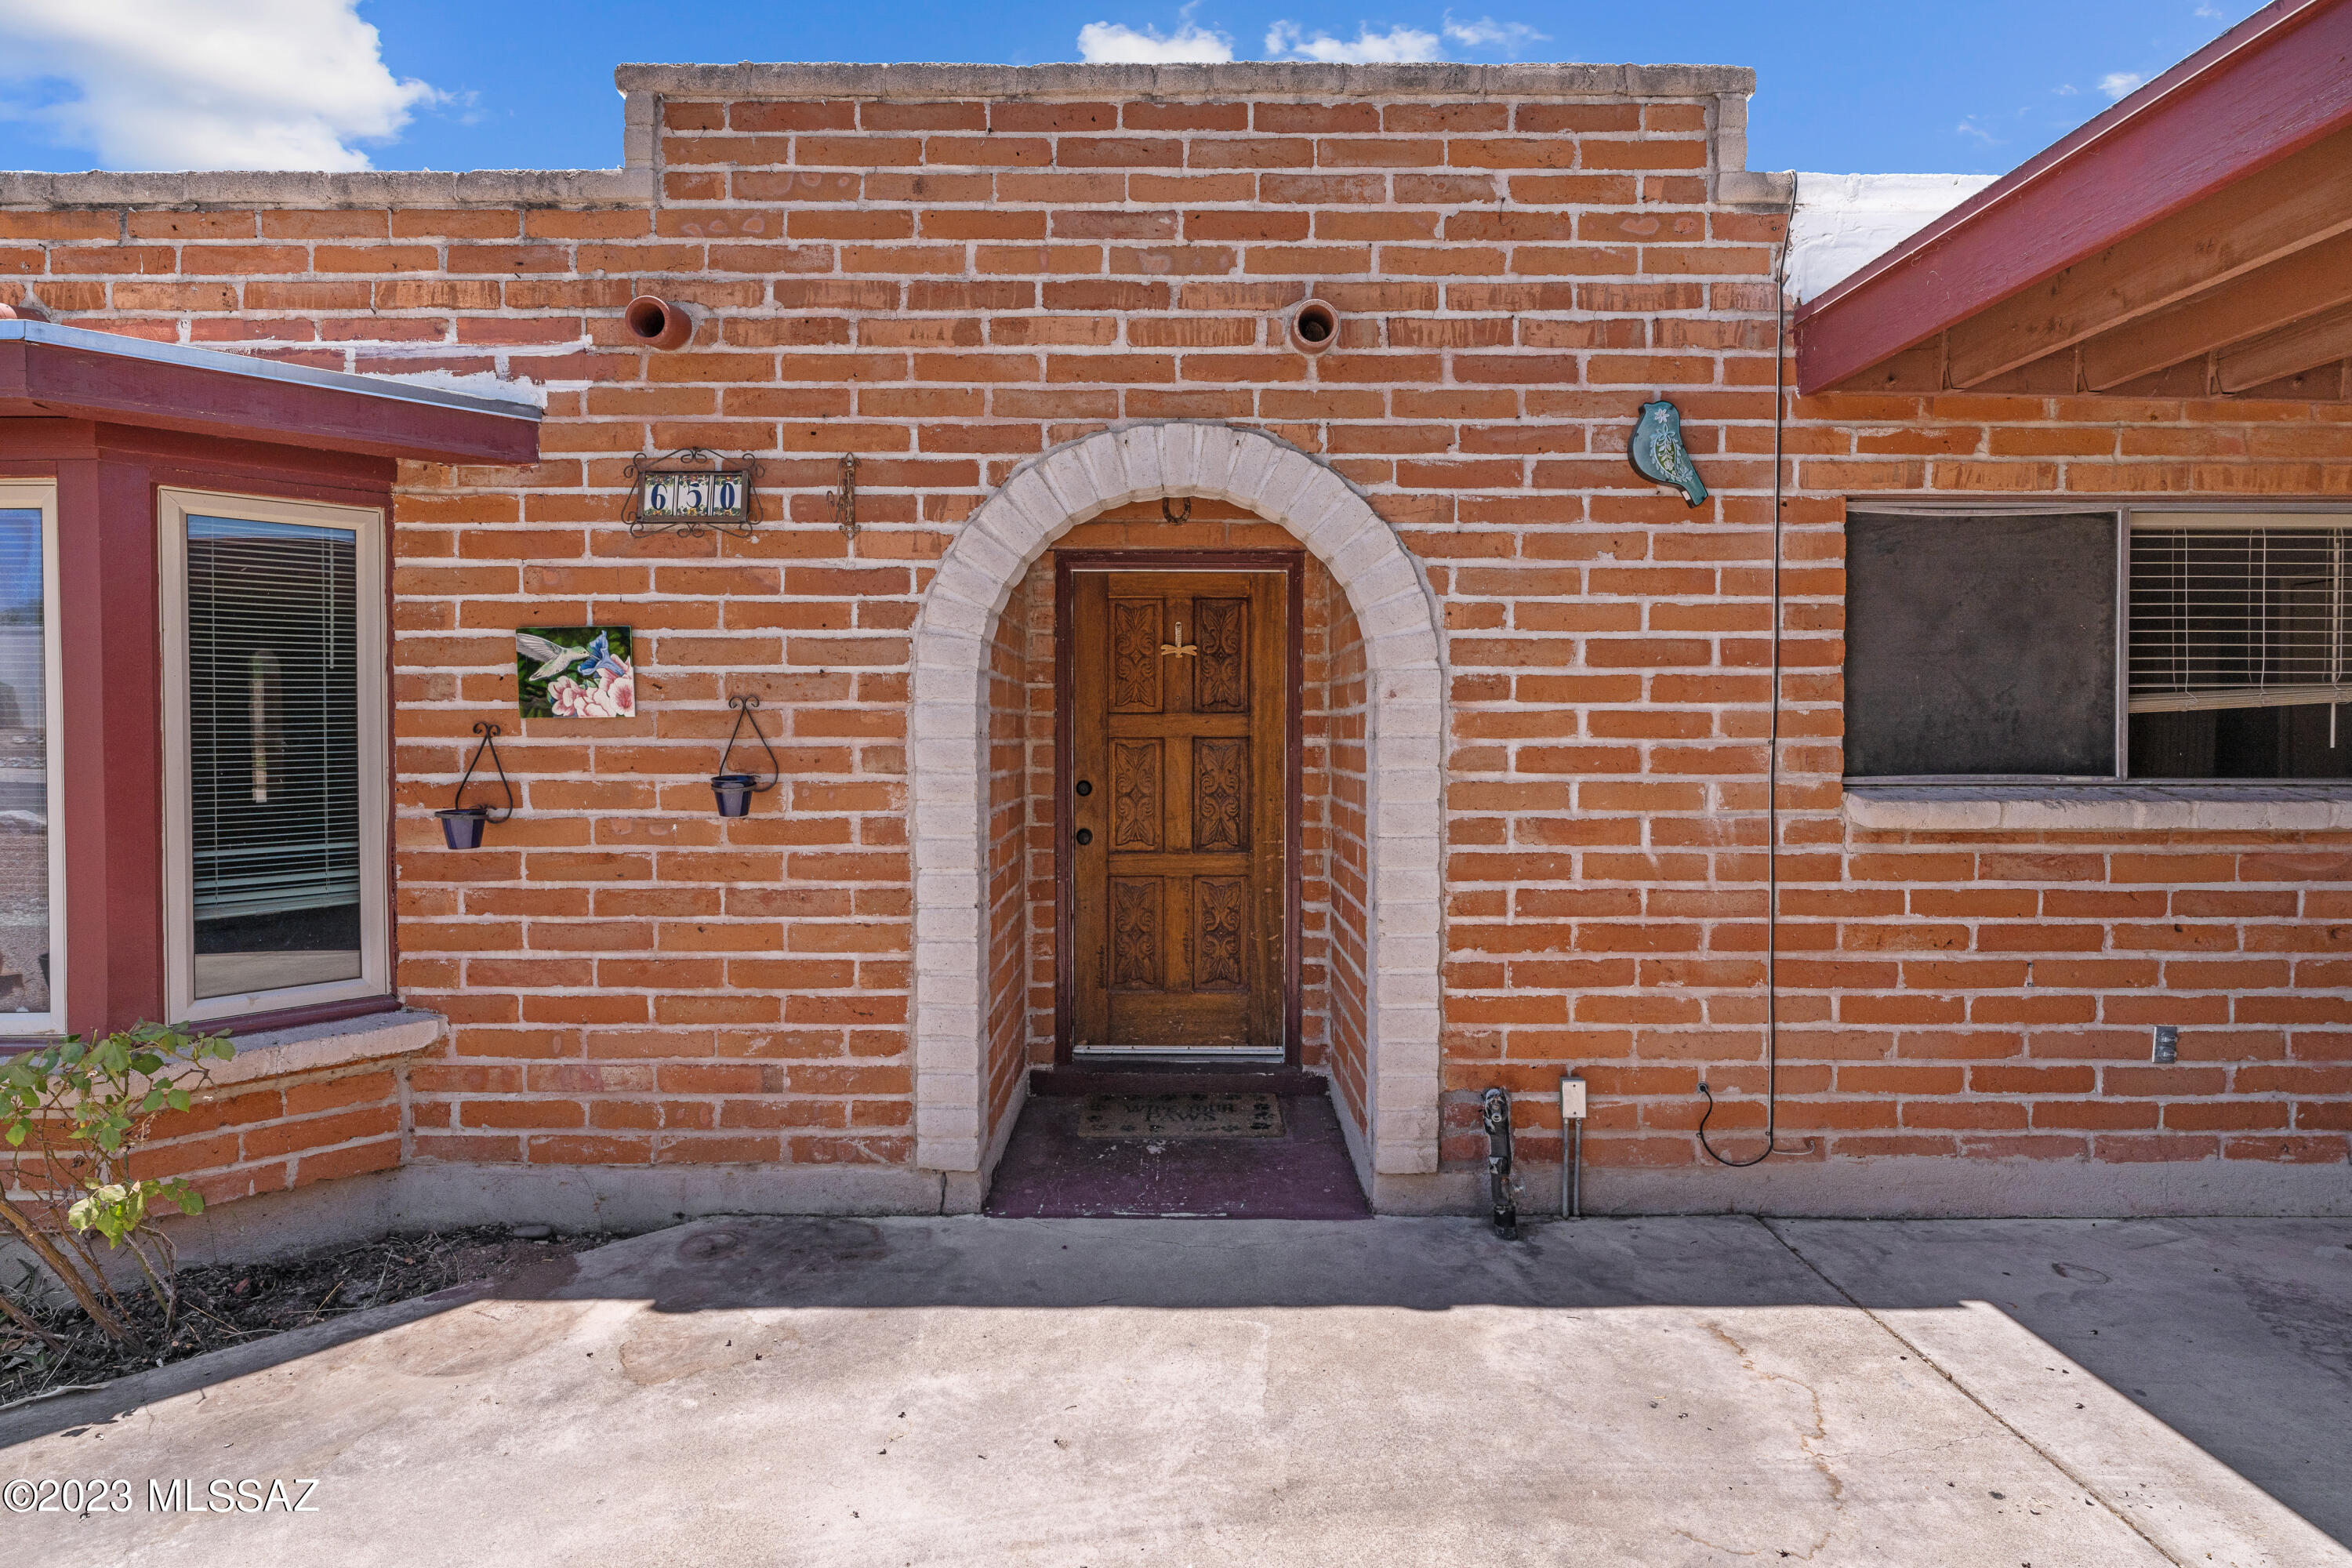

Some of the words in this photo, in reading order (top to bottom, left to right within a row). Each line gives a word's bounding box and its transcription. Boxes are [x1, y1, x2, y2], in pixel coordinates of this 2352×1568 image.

[651, 482, 735, 510] 650
[1124, 1102, 1179, 1114] WIPE
[1186, 1102, 1236, 1113] YOUR
[1144, 1112, 1217, 1122] PAWS
